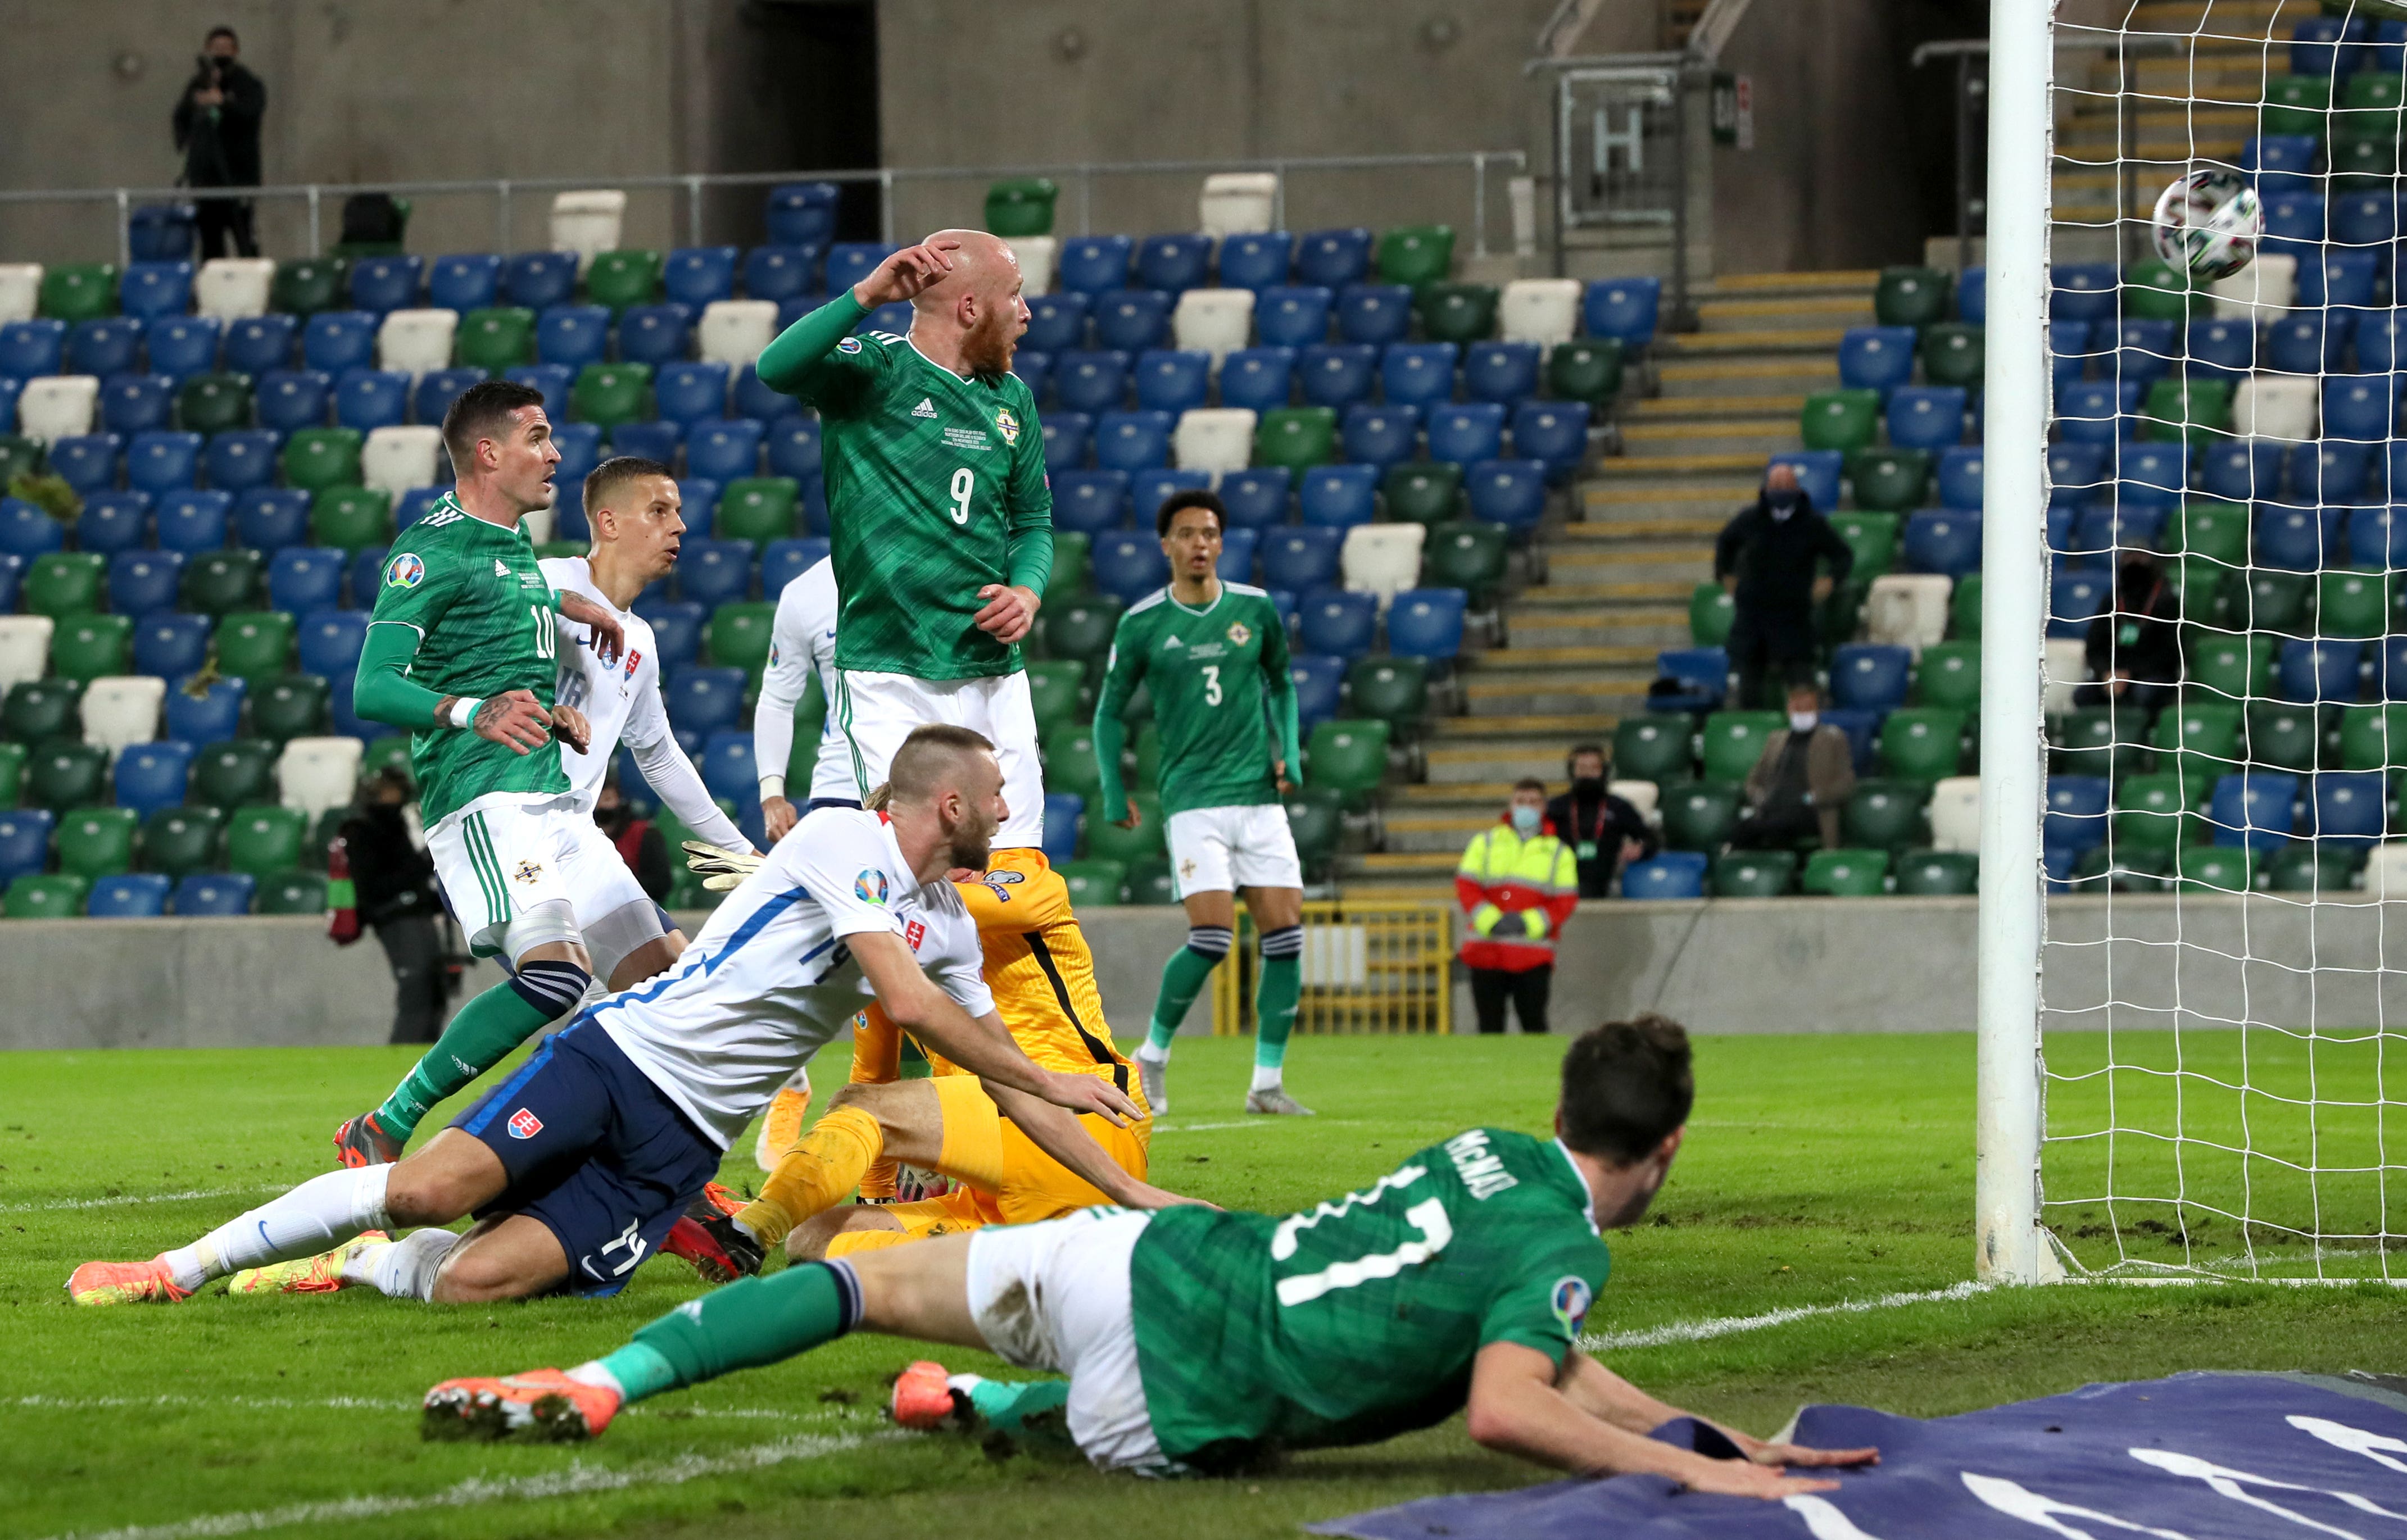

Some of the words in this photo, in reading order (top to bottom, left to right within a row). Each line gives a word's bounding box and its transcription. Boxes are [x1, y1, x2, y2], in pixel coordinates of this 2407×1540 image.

[1594, 108, 1642, 174] H
[950, 467, 974, 525] 9
[531, 605, 555, 660] 10
[1202, 665, 1223, 707] 3
[1271, 1165, 1453, 1307] 17
